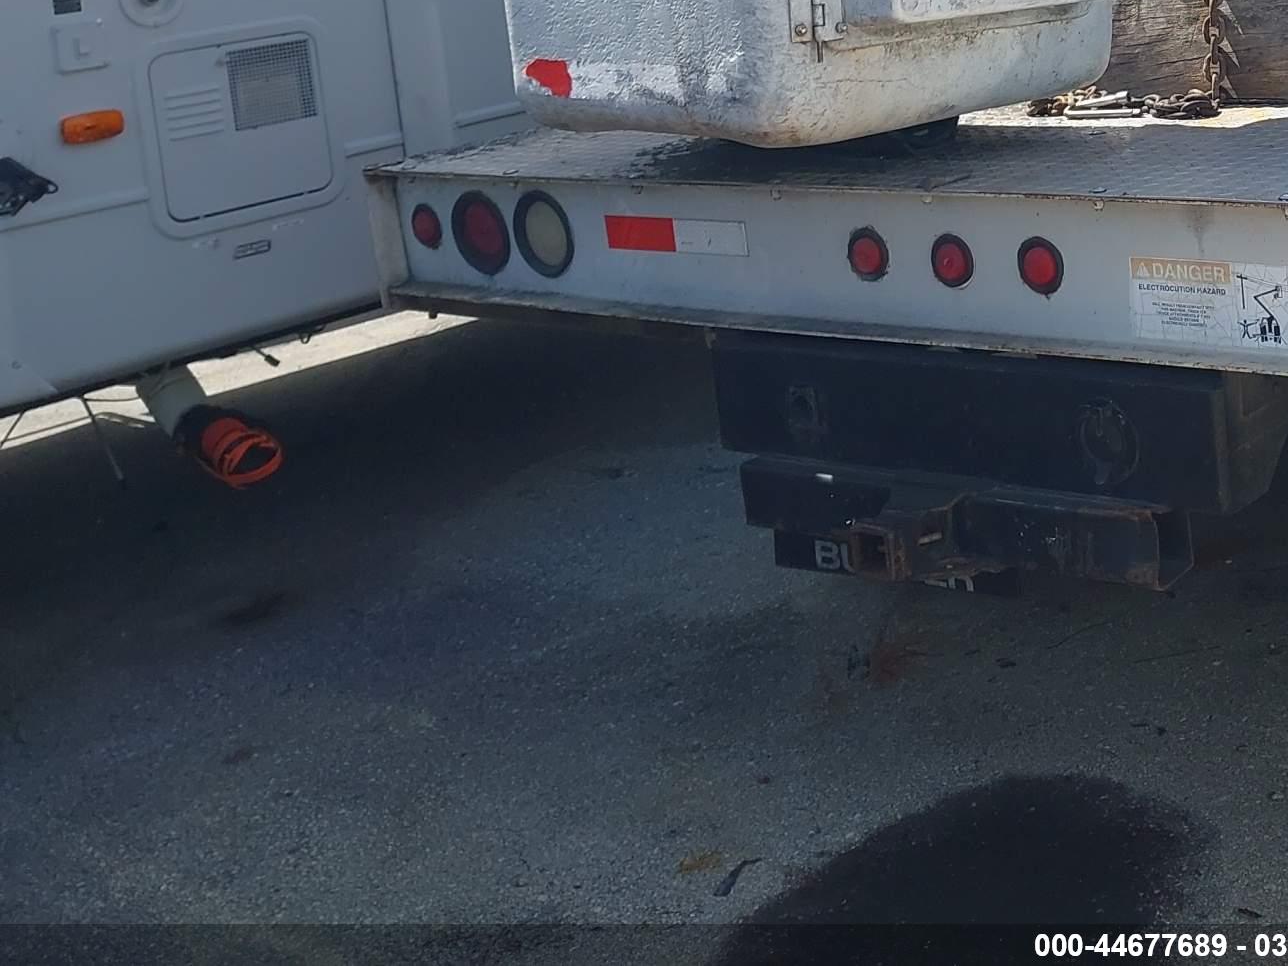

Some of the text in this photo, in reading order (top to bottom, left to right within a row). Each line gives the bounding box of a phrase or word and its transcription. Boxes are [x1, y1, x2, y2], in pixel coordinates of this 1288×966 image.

[1151, 262, 1226, 283] DANGER
[1138, 283, 1227, 296] ELECTROCUTION HAZARD
